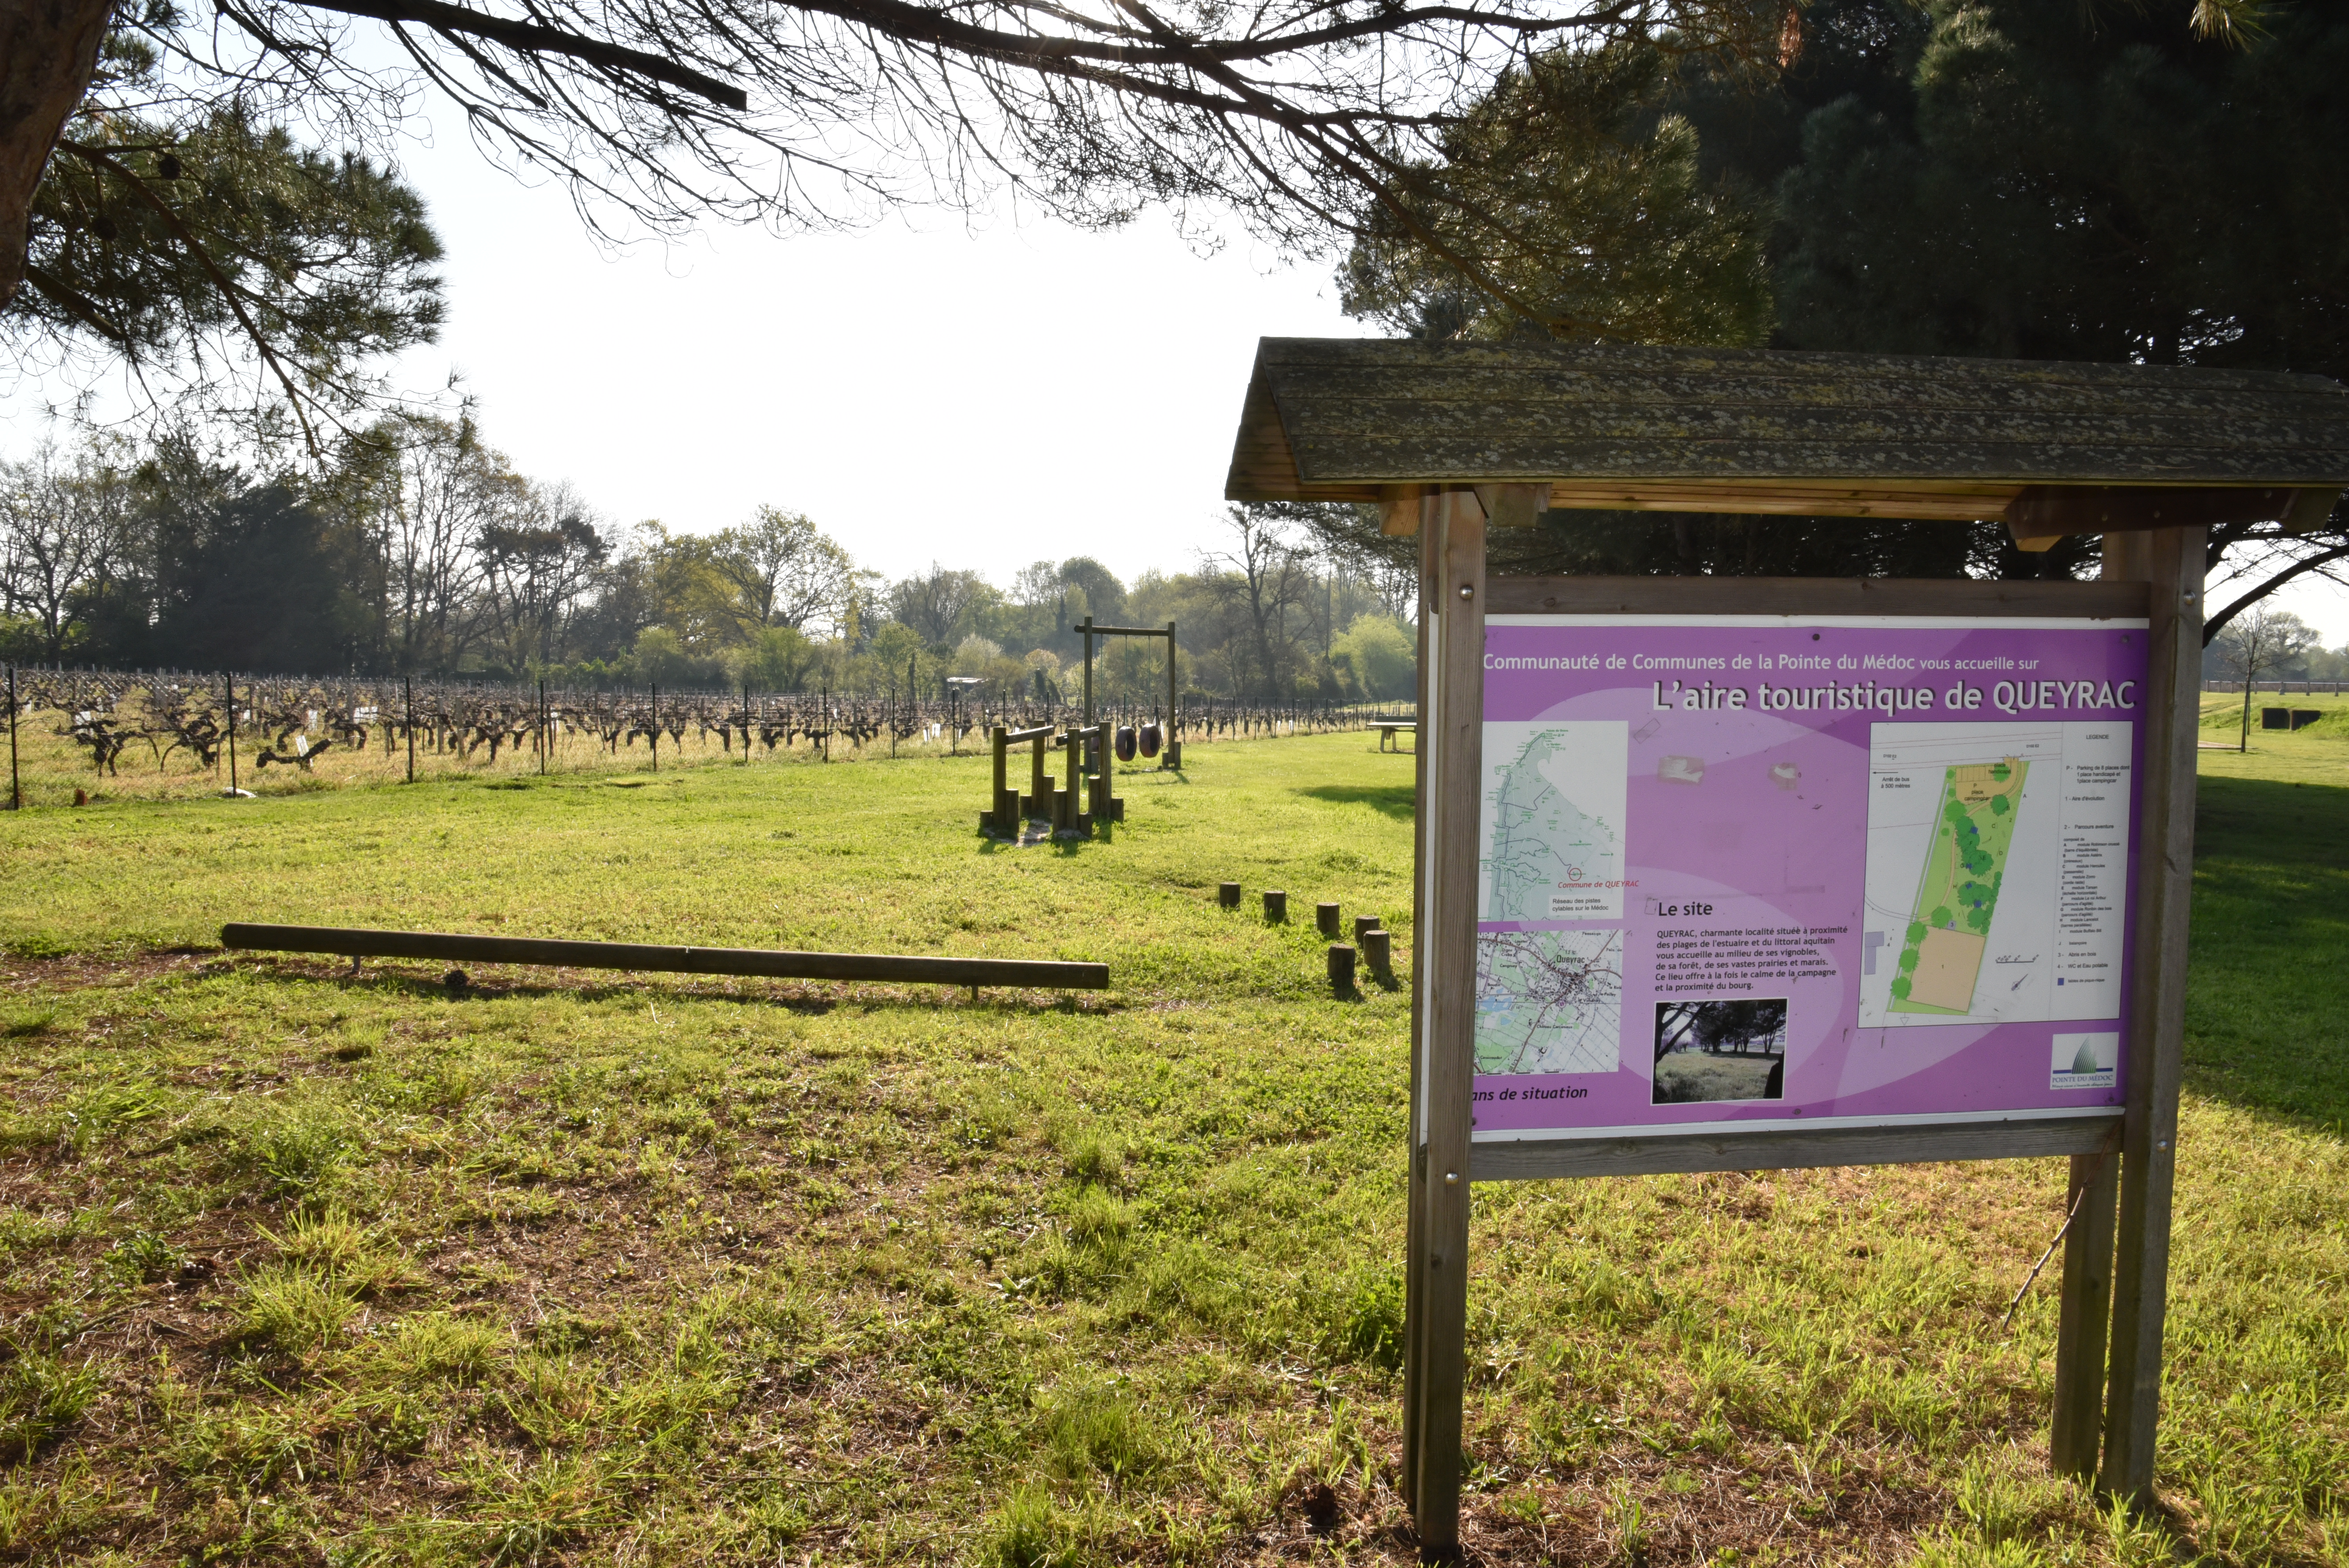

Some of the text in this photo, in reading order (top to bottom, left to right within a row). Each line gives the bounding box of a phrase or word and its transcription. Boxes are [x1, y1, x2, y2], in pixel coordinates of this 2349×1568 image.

[1483, 652, 2039, 670] Communauté de Communes de la Pointe du Médoc vous accueille sur
[1653, 681, 2135, 717] L'aire touristique de QUEYRAC
[1605, 880, 1640, 889] QUEYRAC
[1659, 902, 1713, 916] Le site
[1657, 930, 1697, 939] QUEYRAC,
[1777, 927, 1800, 935] située
[1810, 926, 1848, 935] proximité
[1673, 941, 1697, 950] plages
[1804, 937, 1835, 946] aquitain
[1780, 948, 1819, 957] vignobles,
[1556, 955, 1585, 964] Queyrac
[1679, 962, 1701, 970] forêt,
[1758, 960, 1788, 969] prairies
[1789, 969, 1796, 978] la
[1798, 969, 1836, 977] campagne
[1675, 982, 1714, 993] proximité
[1729, 982, 1753, 990] bourg.
[1499, 1088, 1517, 1100] de
[1522, 1086, 1587, 1099] situation
